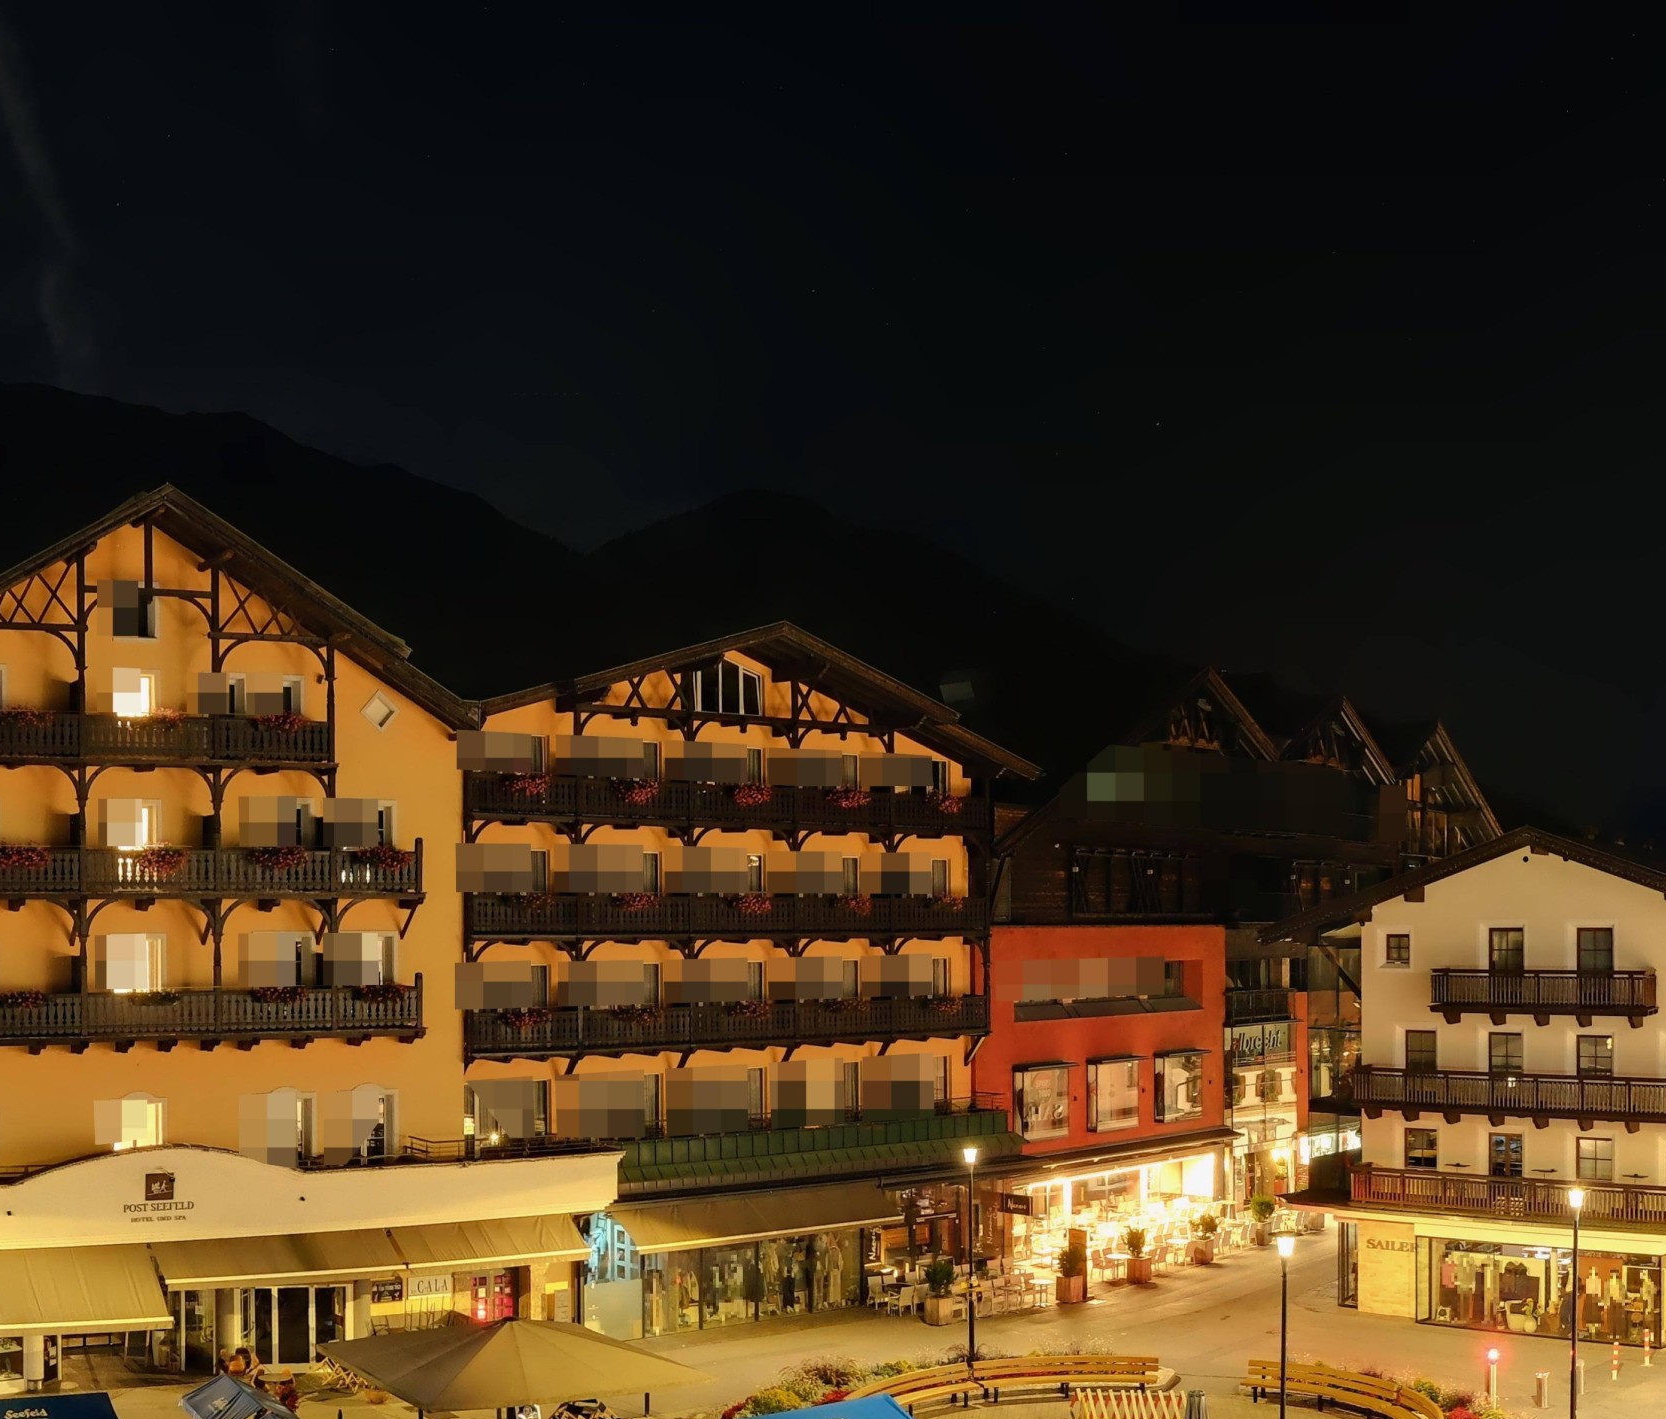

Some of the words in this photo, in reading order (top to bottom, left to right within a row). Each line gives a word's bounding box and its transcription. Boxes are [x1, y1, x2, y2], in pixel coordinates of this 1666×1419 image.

[123, 1203, 148, 1213] POST
[150, 1201, 194, 1212] SEEFELD
[4, 1408, 48, 1419] Seefeld
